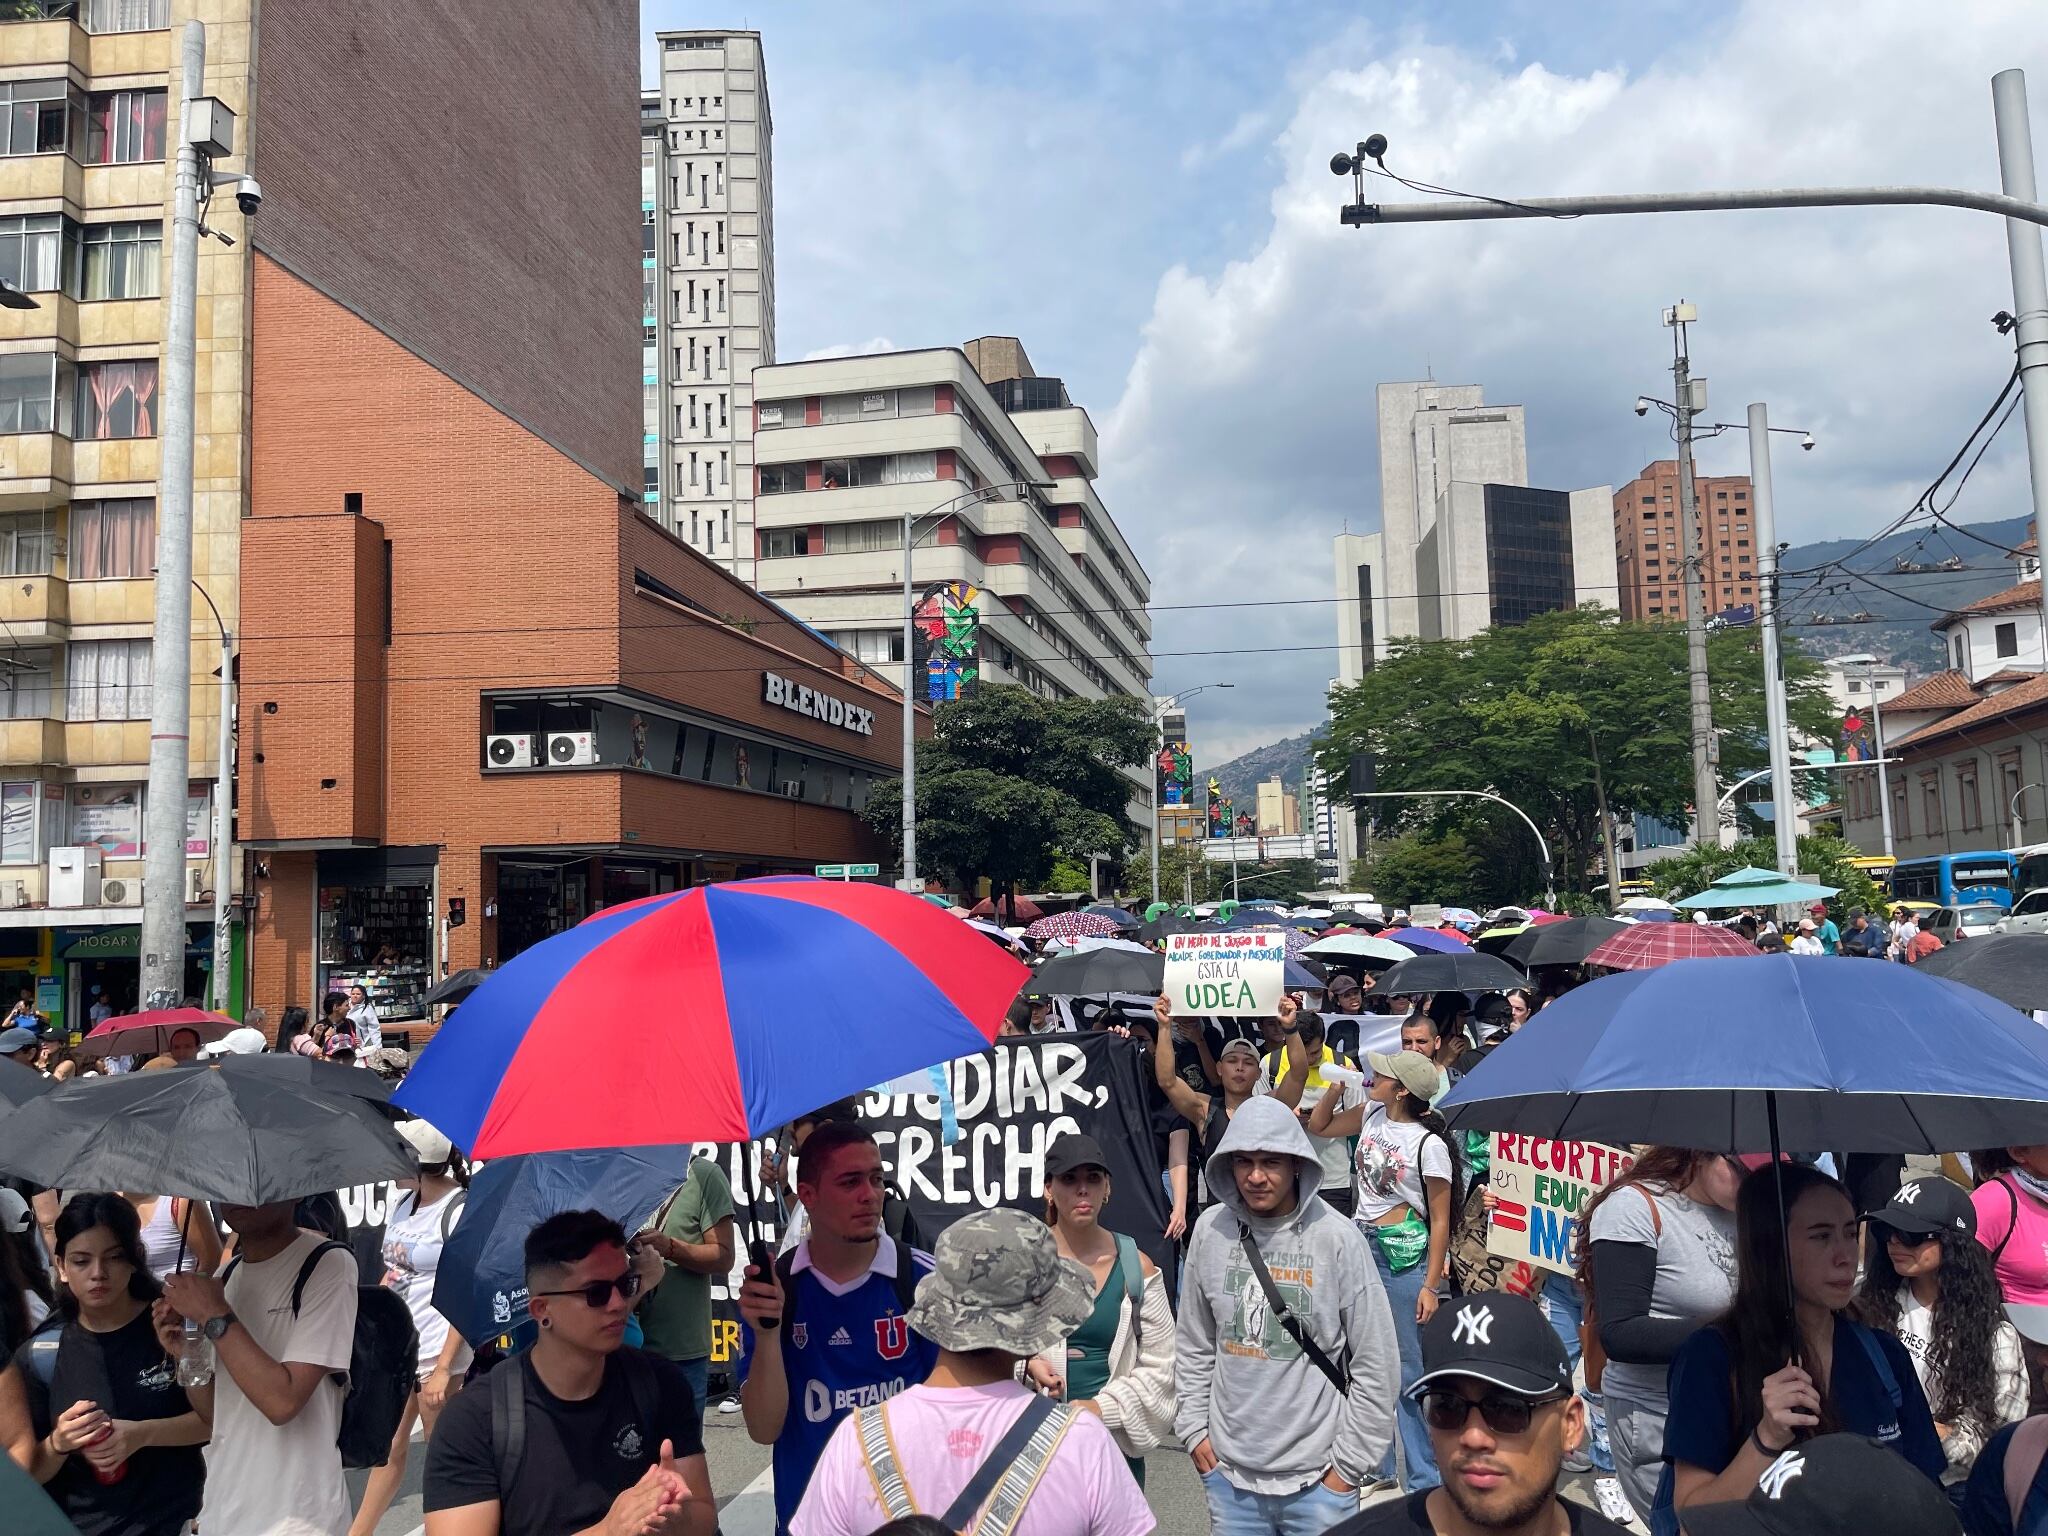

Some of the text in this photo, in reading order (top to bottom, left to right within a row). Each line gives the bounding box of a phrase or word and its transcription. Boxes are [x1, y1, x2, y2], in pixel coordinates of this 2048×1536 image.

[766, 672, 873, 736] BLENDEX
[1871, 868, 1889, 876] BOSTO
[79, 935, 128, 947] HOGAR
[1174, 936, 1185, 949] EN
[1188, 934, 1208, 948] MEDIO
[1210, 935, 1222, 948] DEL
[1225, 935, 1252, 948] JUEGO
[1198, 949, 1242, 961] GOBERNADOR
[1226, 961, 1240, 979] LA
[1185, 979, 1257, 1010] UDEA
[1370, 1133, 1401, 1155] always
[1493, 1169, 1599, 1218] en EDUC
[1893, 1182, 1922, 1205] NY
[874, 1314, 910, 1361] U
[1452, 1304, 1494, 1345] NY
[711, 1319, 739, 1362] ER
[828, 1338, 853, 1346] adidas
[834, 1376, 905, 1410] BETANO
[1759, 1450, 1806, 1500] NY
